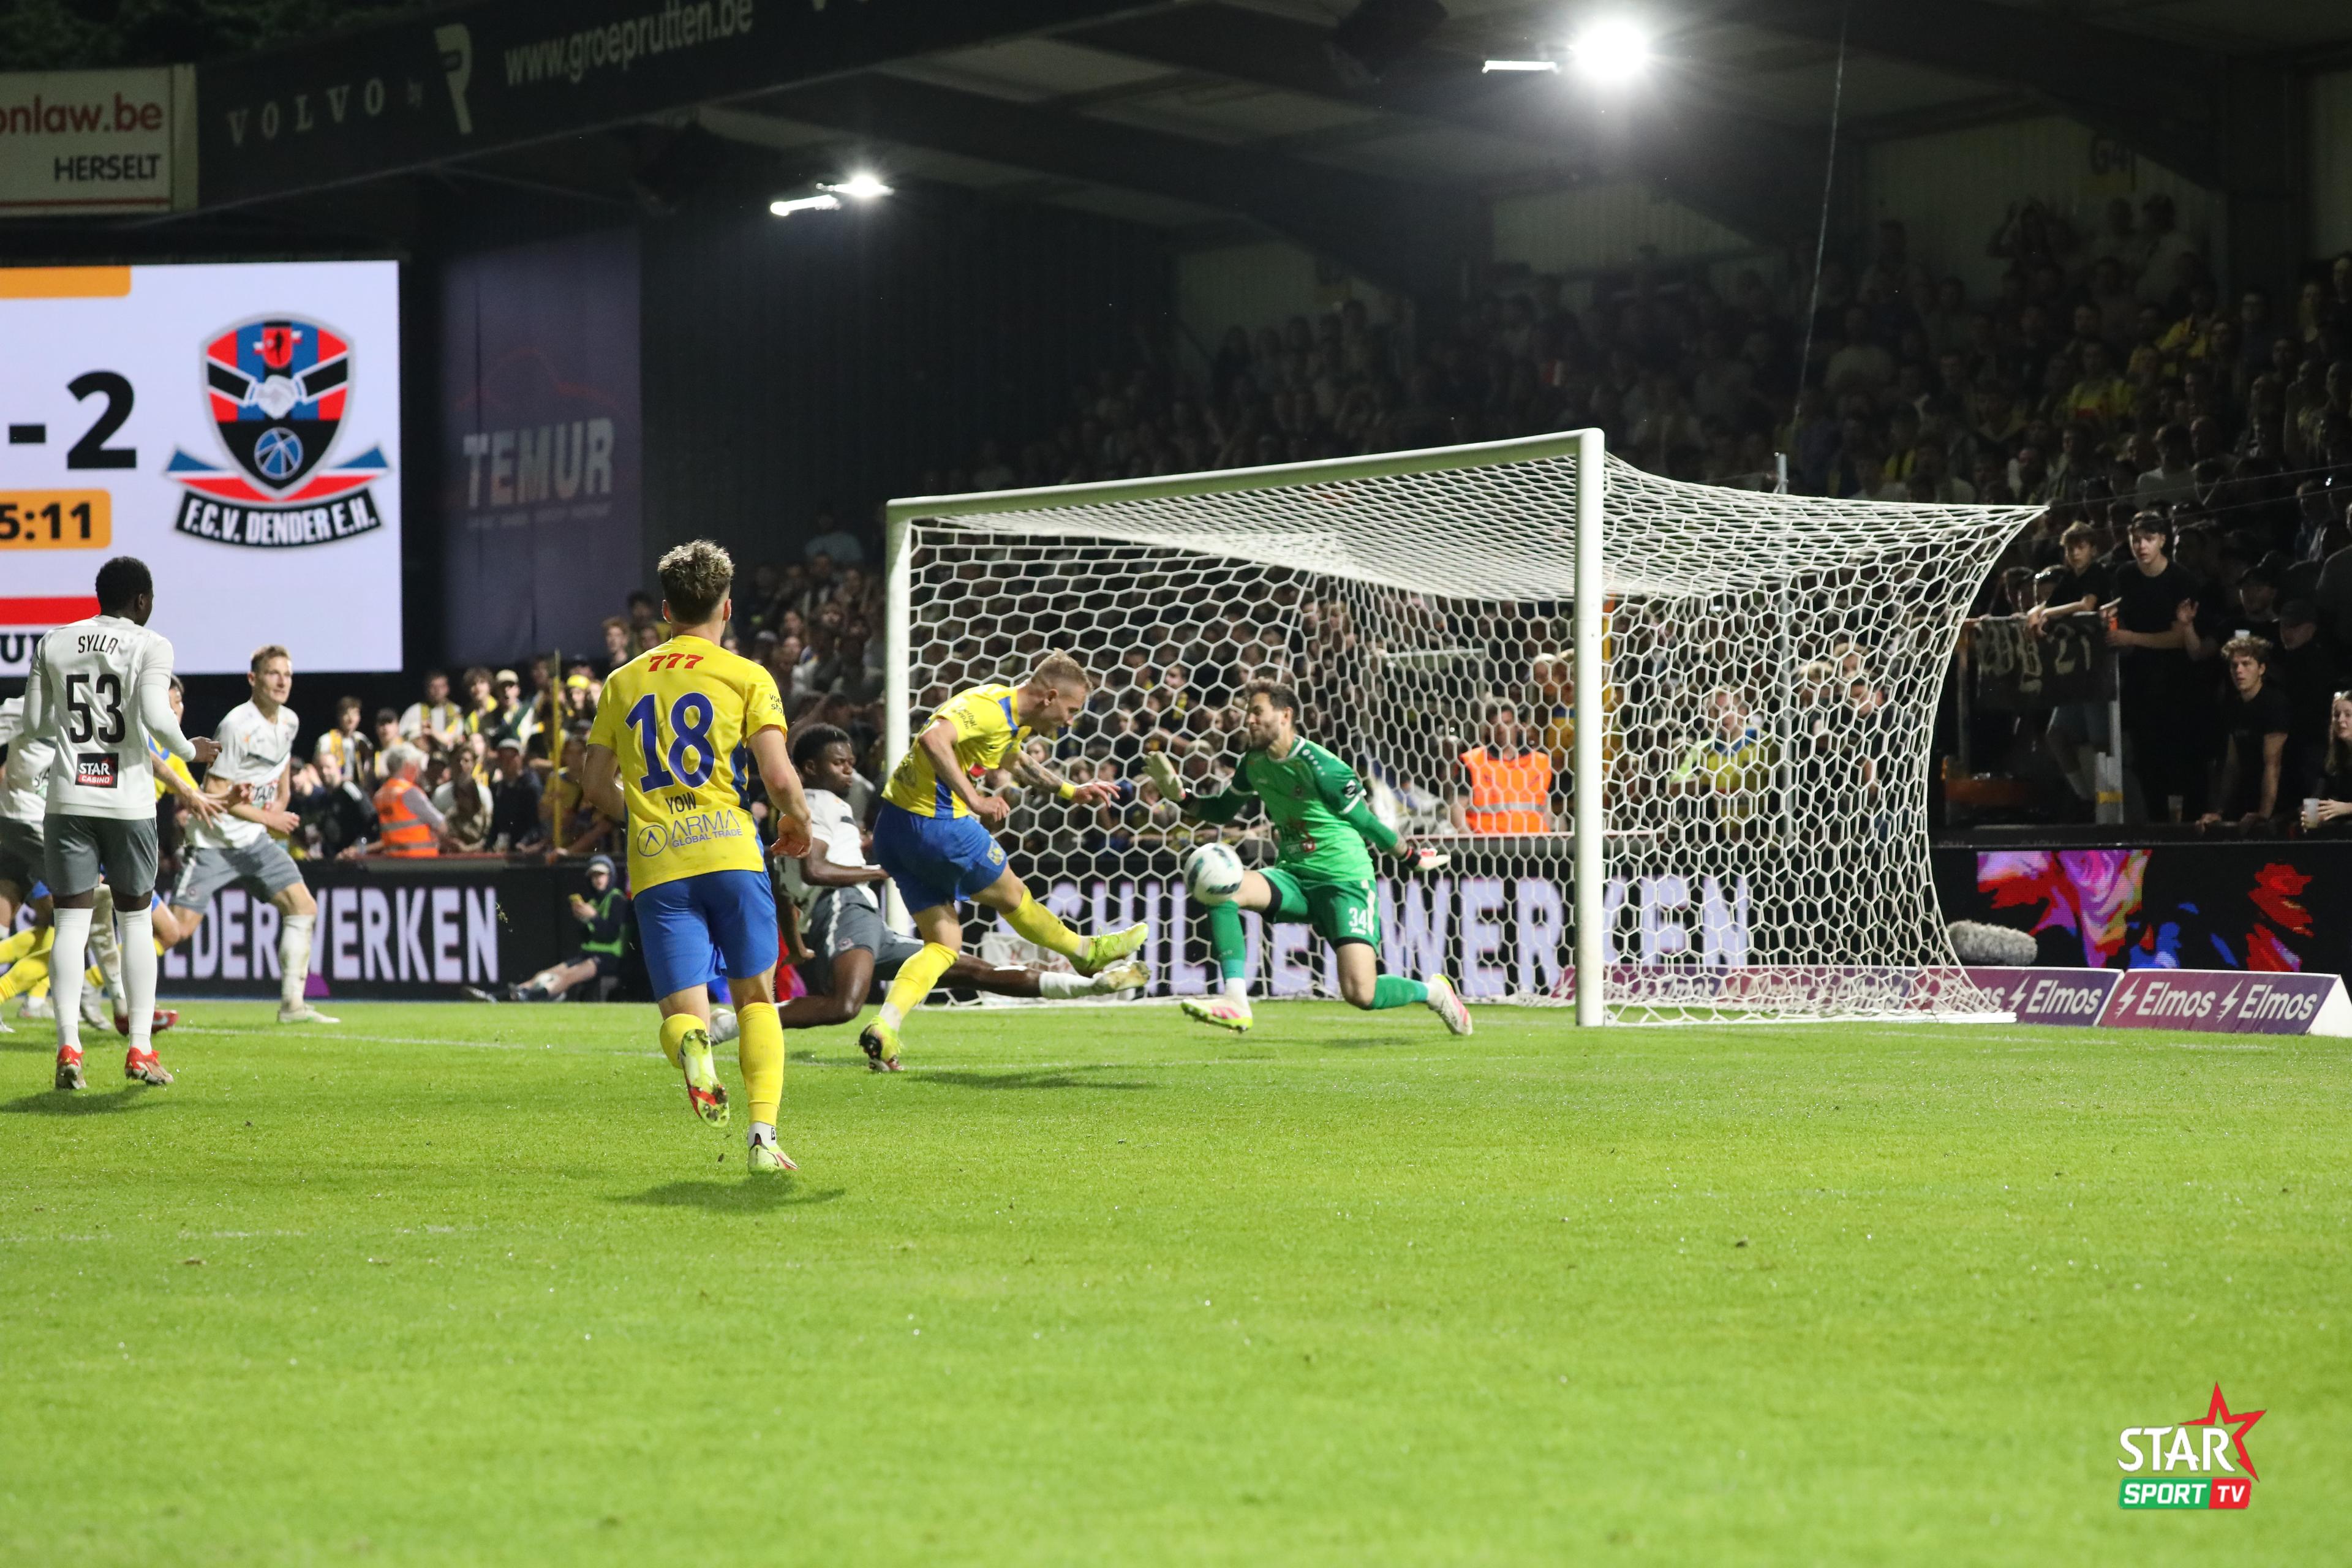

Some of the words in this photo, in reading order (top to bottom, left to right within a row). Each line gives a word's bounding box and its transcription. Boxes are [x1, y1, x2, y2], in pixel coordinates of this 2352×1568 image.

[227, 77, 385, 147] VOLVO
[55, 154, 160, 181] HERSELT
[462, 417, 614, 509] TEMUR
[245, 507, 332, 545] DENDER
[78, 635, 119, 655] SYLLA
[648, 653, 704, 672] 777
[66, 674, 126, 743] 53
[625, 692, 716, 794] 18
[78, 762, 110, 775] STAR
[665, 791, 696, 815] YOW
[671, 809, 741, 839] ARMA
[672, 834, 712, 848] GLOBAL
[712, 829, 743, 839] TRADE
[1349, 907, 1367, 929] 34
[2026, 979, 2101, 1015] Elmos
[2136, 981, 2216, 1017] Elmos
[2237, 984, 2317, 1020] Elmos
